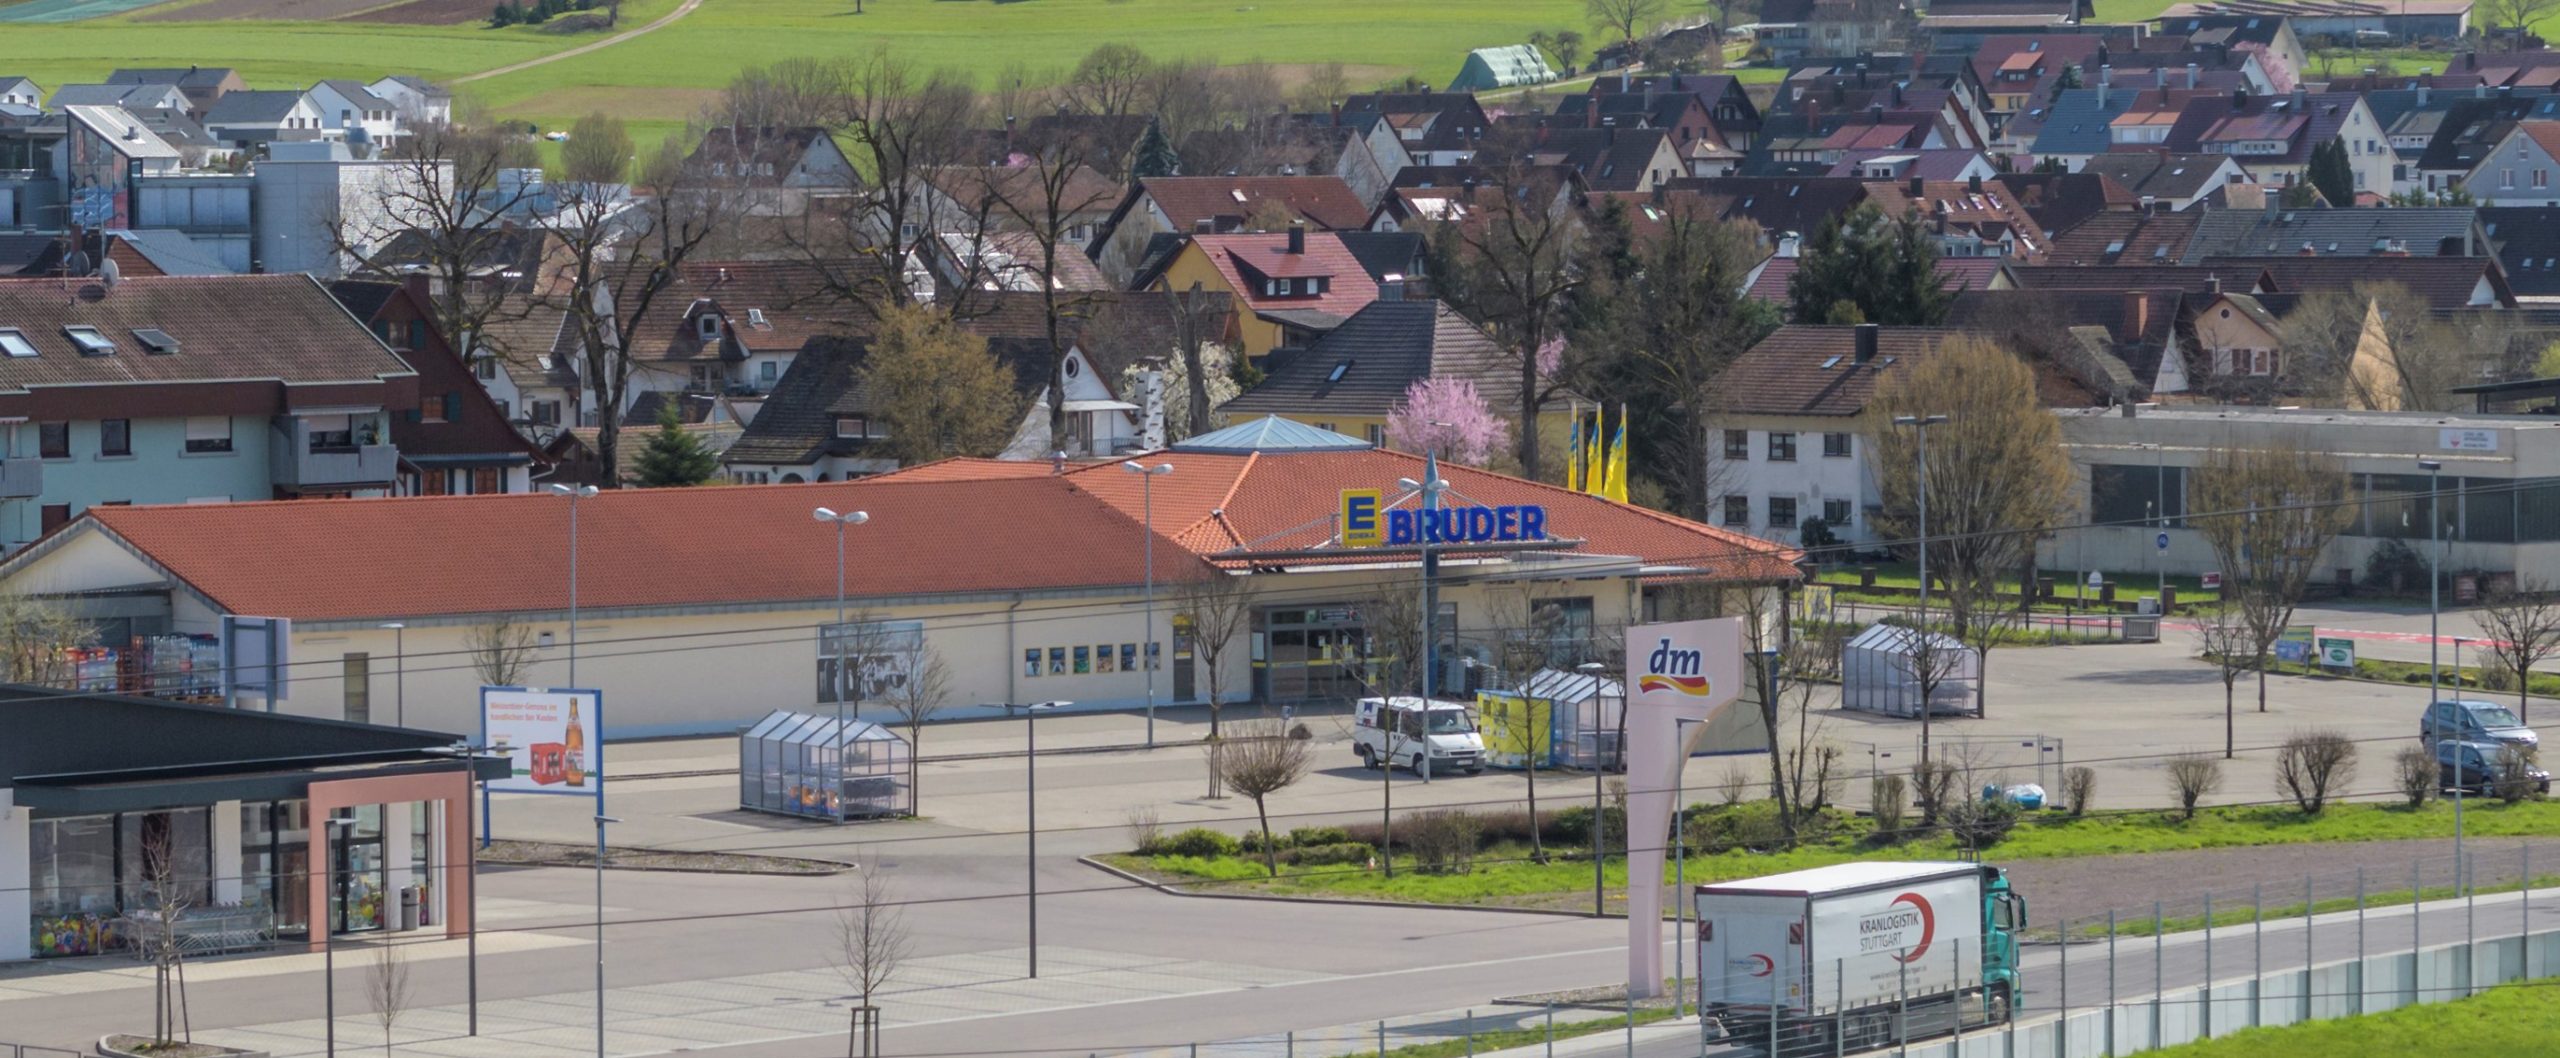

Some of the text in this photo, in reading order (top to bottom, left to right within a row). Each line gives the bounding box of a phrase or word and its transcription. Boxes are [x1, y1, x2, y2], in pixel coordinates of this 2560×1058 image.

[1349, 496, 1375, 530] E
[1389, 505, 1545, 545] BRUDER
[1650, 639, 1701, 675] dm
[1860, 912, 1919, 934] KRANLOGISTIK
[1860, 932, 1902, 952] STUTTGART
